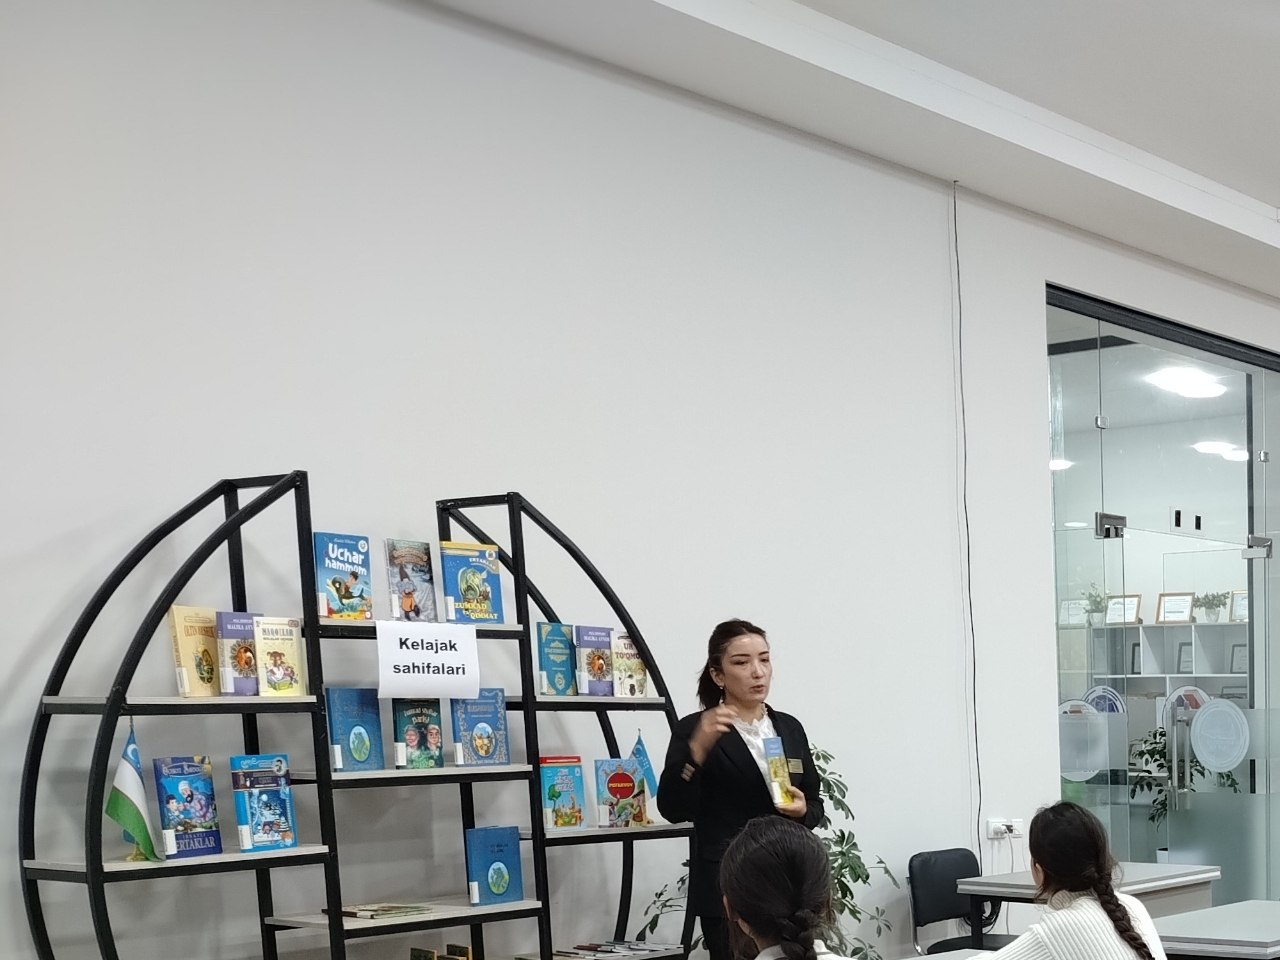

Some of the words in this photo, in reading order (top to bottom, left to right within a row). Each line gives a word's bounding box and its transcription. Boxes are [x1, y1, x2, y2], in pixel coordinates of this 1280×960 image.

[328, 543, 365, 565] Uchar
[325, 558, 368, 576] hammom
[398, 637, 458, 654] Kelajak
[615, 652, 642, 660] TO'QMO
[392, 662, 466, 676] sahifalari
[175, 837, 216, 851] ERTAKLAR
